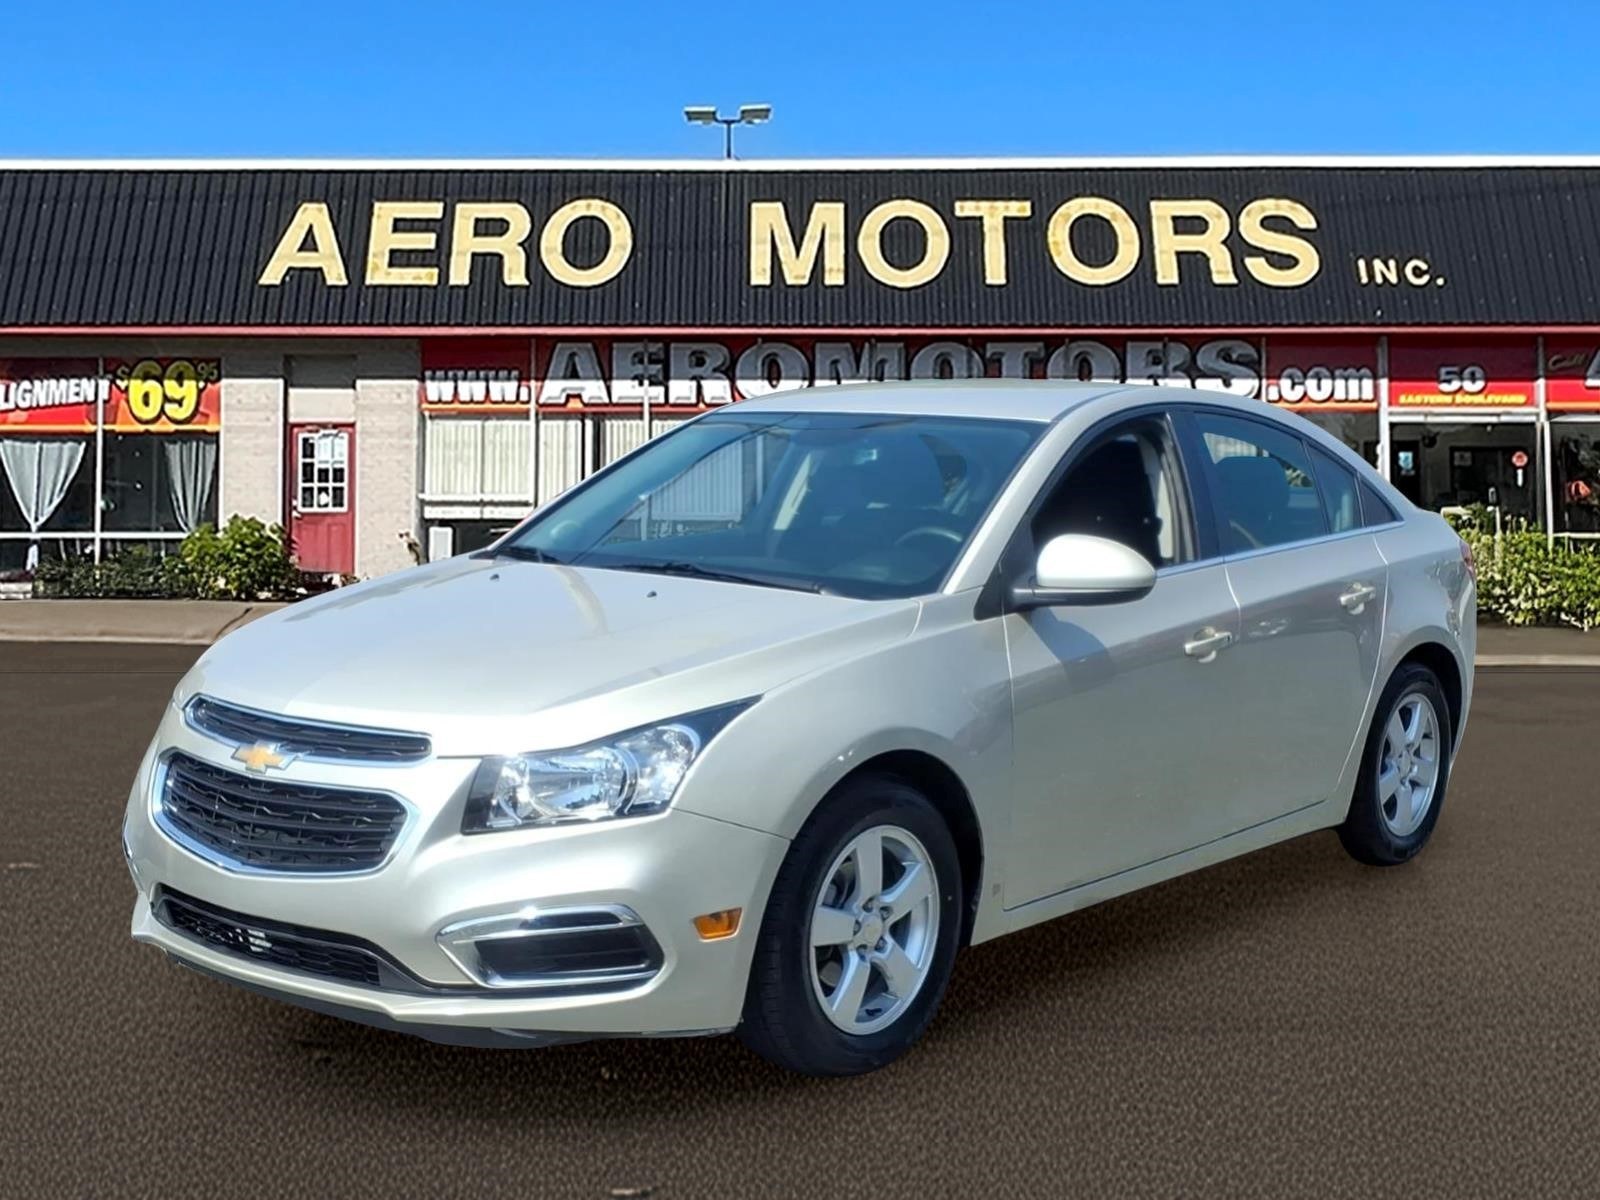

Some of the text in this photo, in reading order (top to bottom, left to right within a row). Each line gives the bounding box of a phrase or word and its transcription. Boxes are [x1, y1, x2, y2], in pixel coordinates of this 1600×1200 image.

[257, 196, 1446, 288] AERO MOTORS INC.
[1437, 365, 1486, 393] 50
[1399, 393, 1528, 404] EASTERN BOULEVARD
